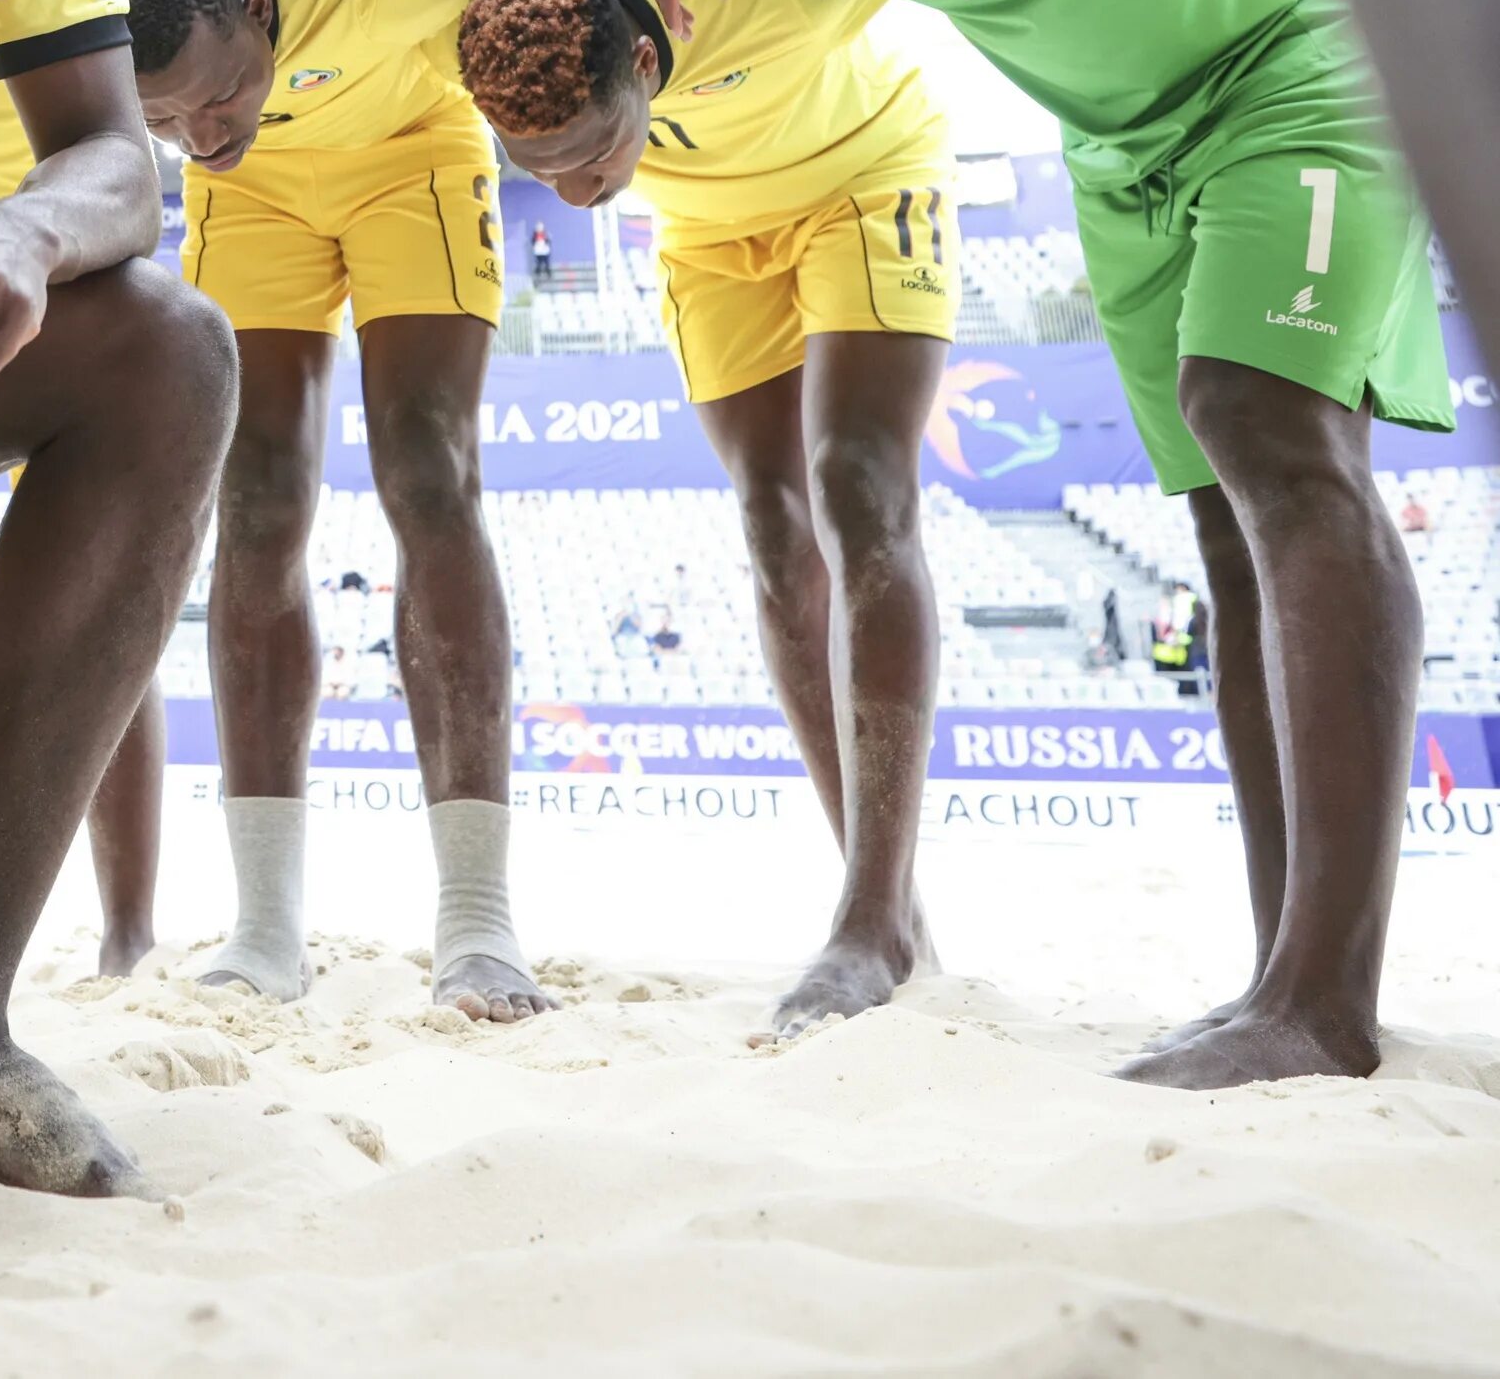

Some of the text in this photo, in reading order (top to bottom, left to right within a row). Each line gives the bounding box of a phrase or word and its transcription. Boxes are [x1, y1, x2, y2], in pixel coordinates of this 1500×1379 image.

[894, 187, 943, 265] 11
[1301, 168, 1337, 274] 1
[1265, 309, 1339, 337] Lacatoni
[310, 719, 389, 752] FIFA
[531, 723, 690, 759] SOCCER
[694, 724, 801, 761] WOR
[952, 725, 1162, 769] RUSSIA
[1169, 727, 1229, 772] 20
[514, 784, 782, 818] #REACHOUT
